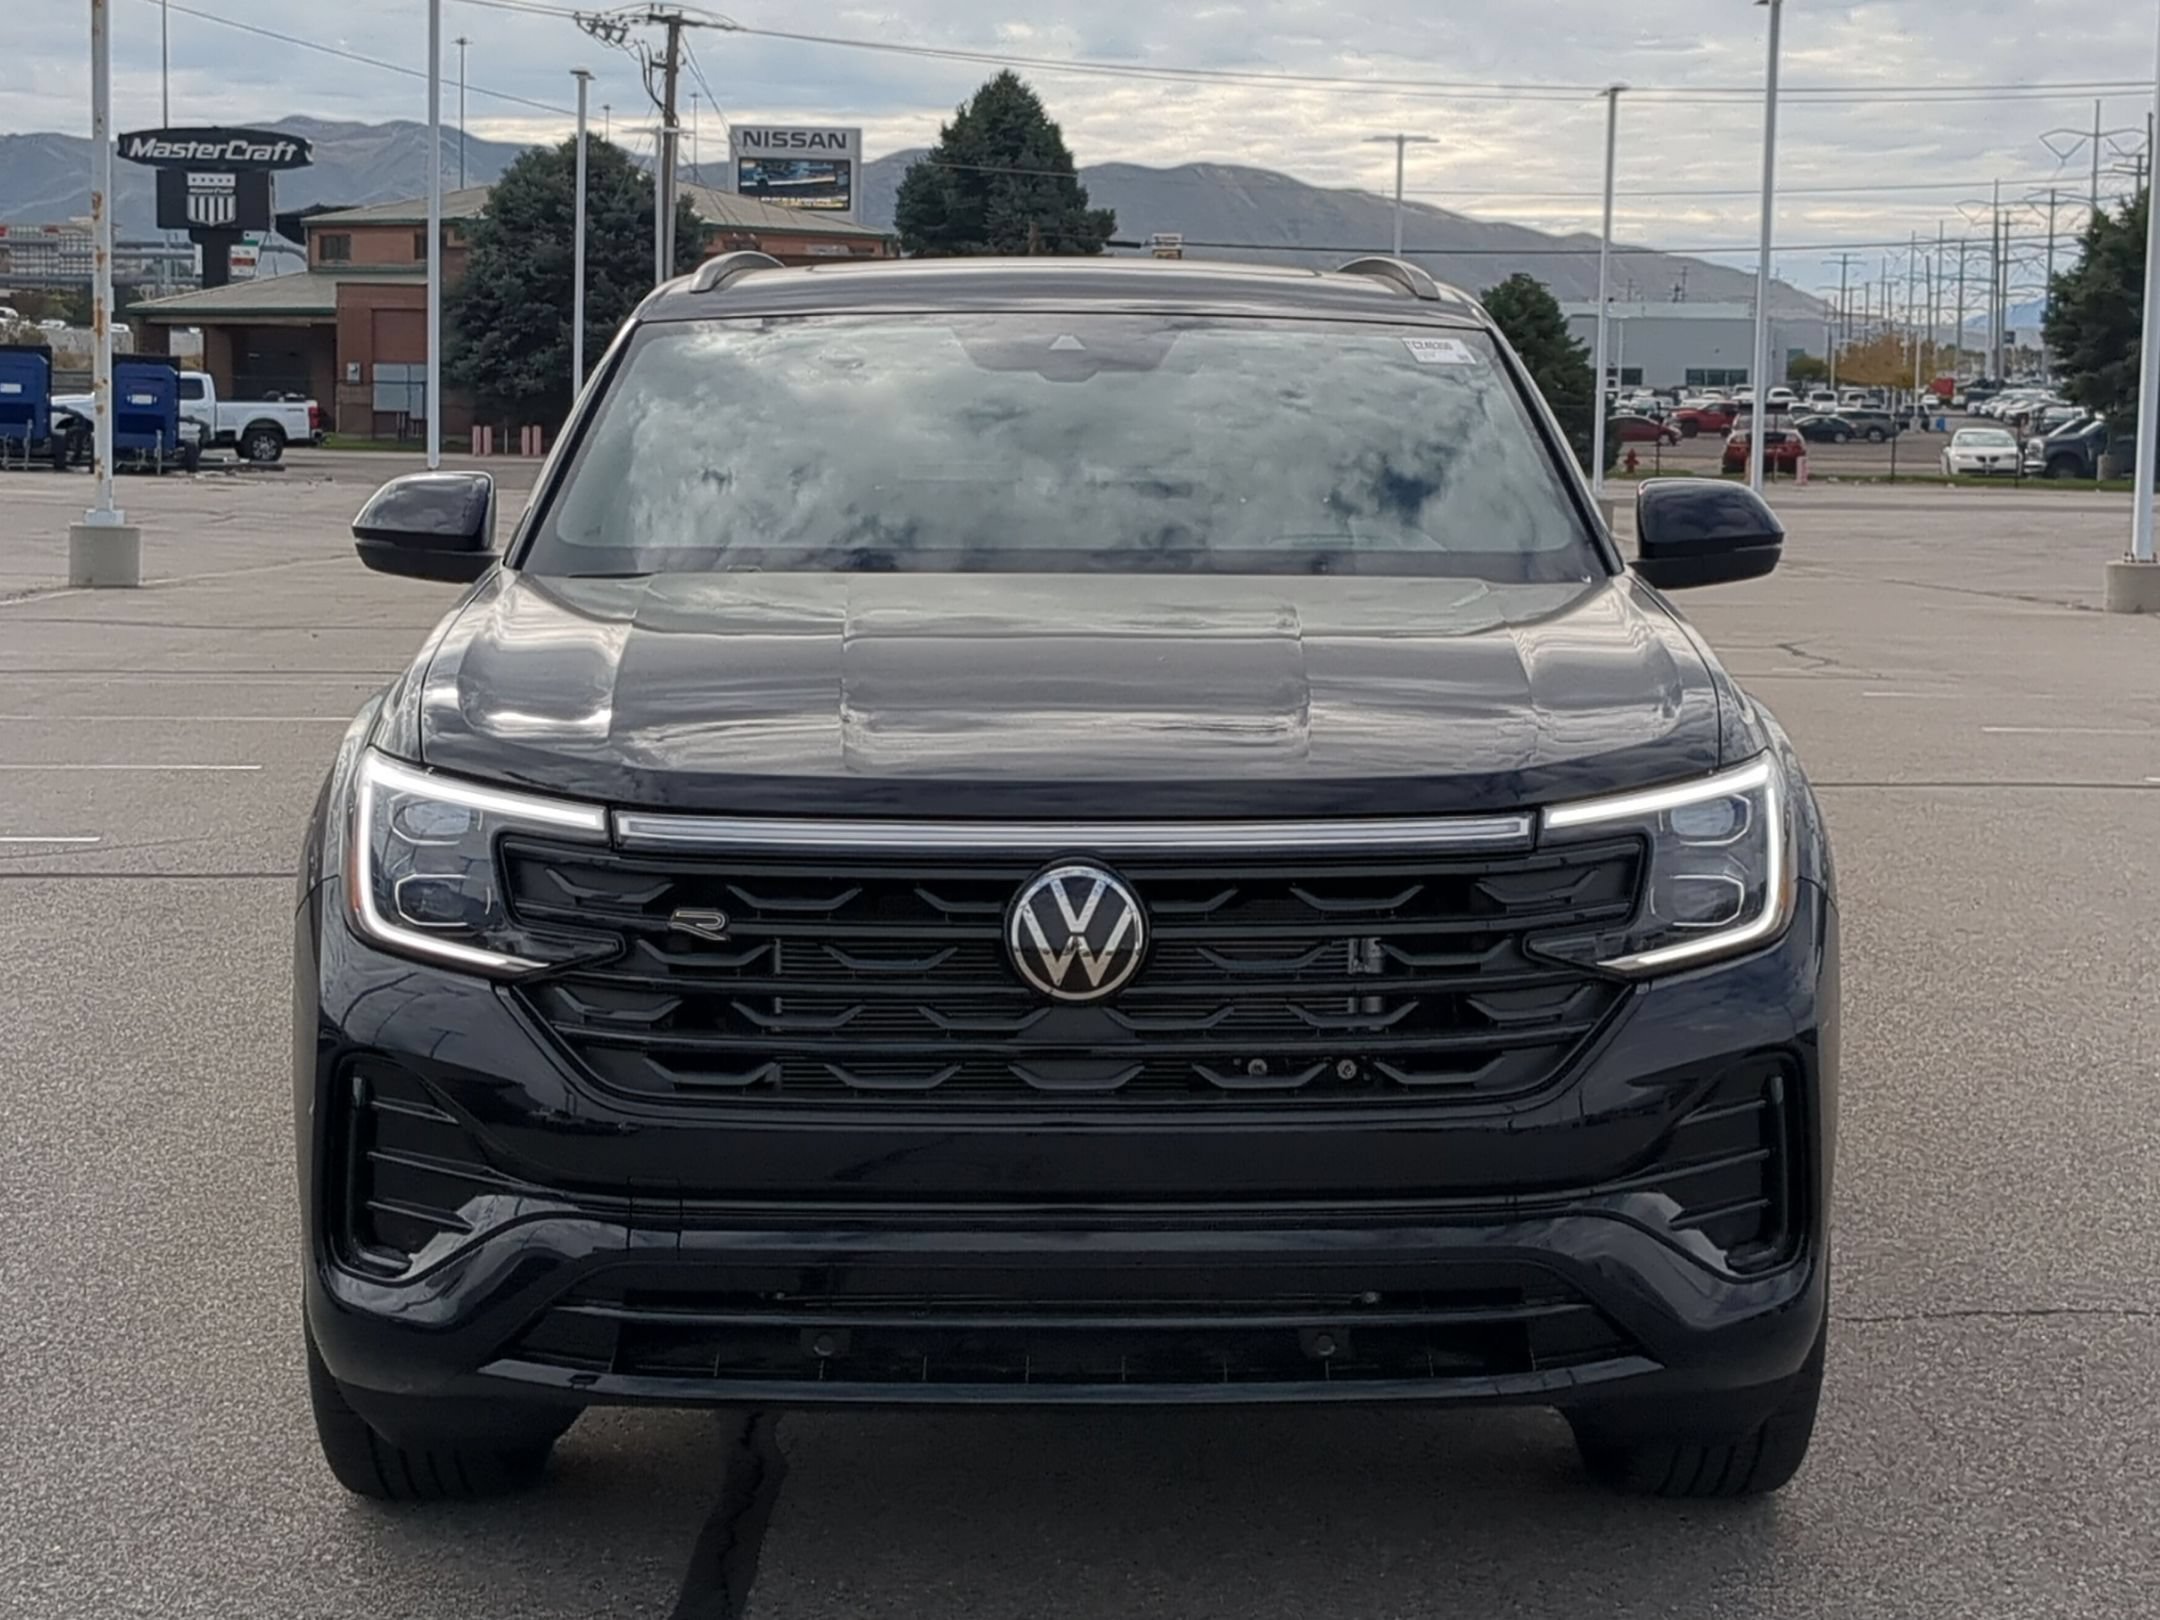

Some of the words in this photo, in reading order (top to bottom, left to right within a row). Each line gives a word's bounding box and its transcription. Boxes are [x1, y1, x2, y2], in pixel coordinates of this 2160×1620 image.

[129, 137, 299, 162] MasterCraft
[742, 130, 847, 149] NISSAN
[670, 909, 727, 941] R
